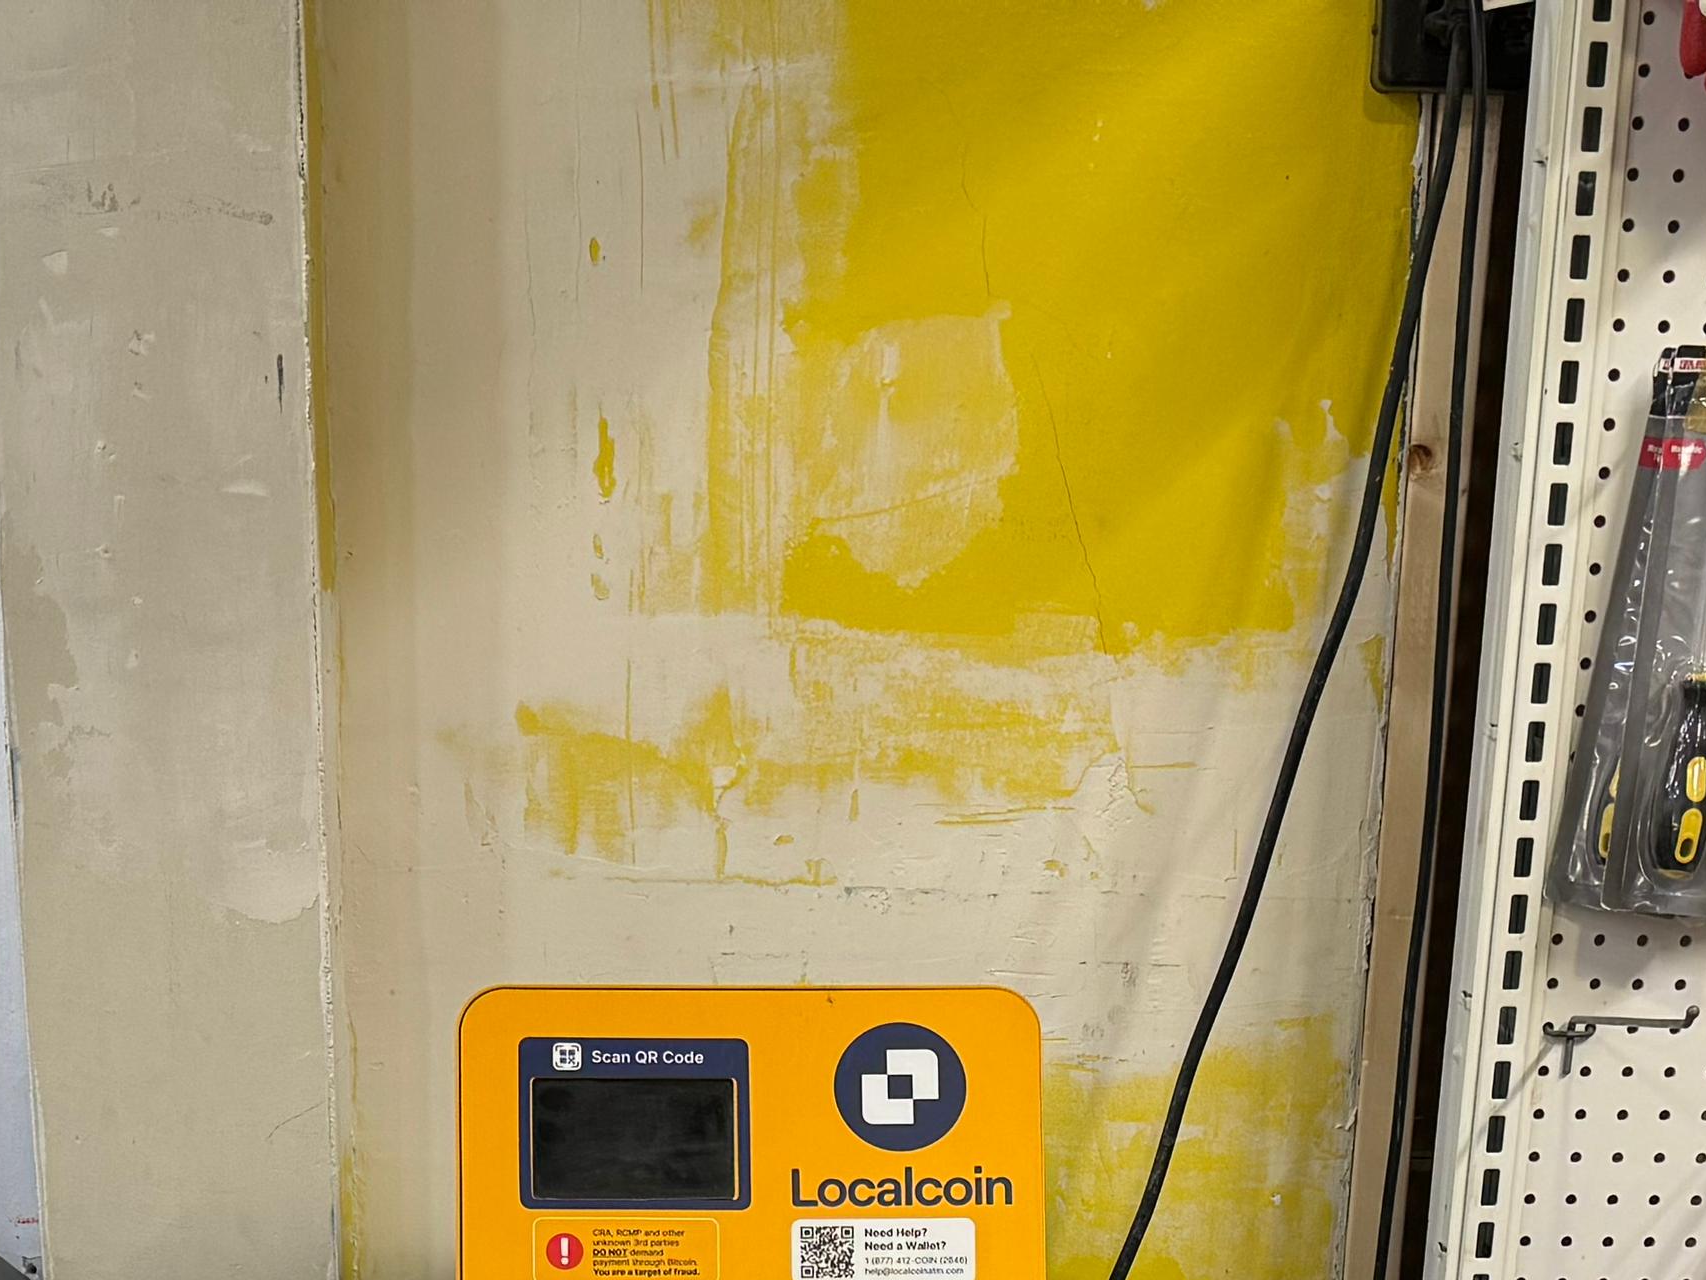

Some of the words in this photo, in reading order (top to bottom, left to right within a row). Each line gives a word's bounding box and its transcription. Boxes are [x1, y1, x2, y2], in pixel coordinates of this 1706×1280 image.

[592, 1051, 629, 1064] Scan
[635, 1050, 658, 1065] QR
[663, 1050, 704, 1064] Code
[792, 1166, 1012, 1207] Localcoin
[865, 1228, 893, 1237] Need
[897, 1228, 927, 1238] Help?
[865, 1242, 893, 1250] Need
[906, 1241, 946, 1250] Wallet?
[865, 1268, 964, 1276] help@localcoinatm.com
